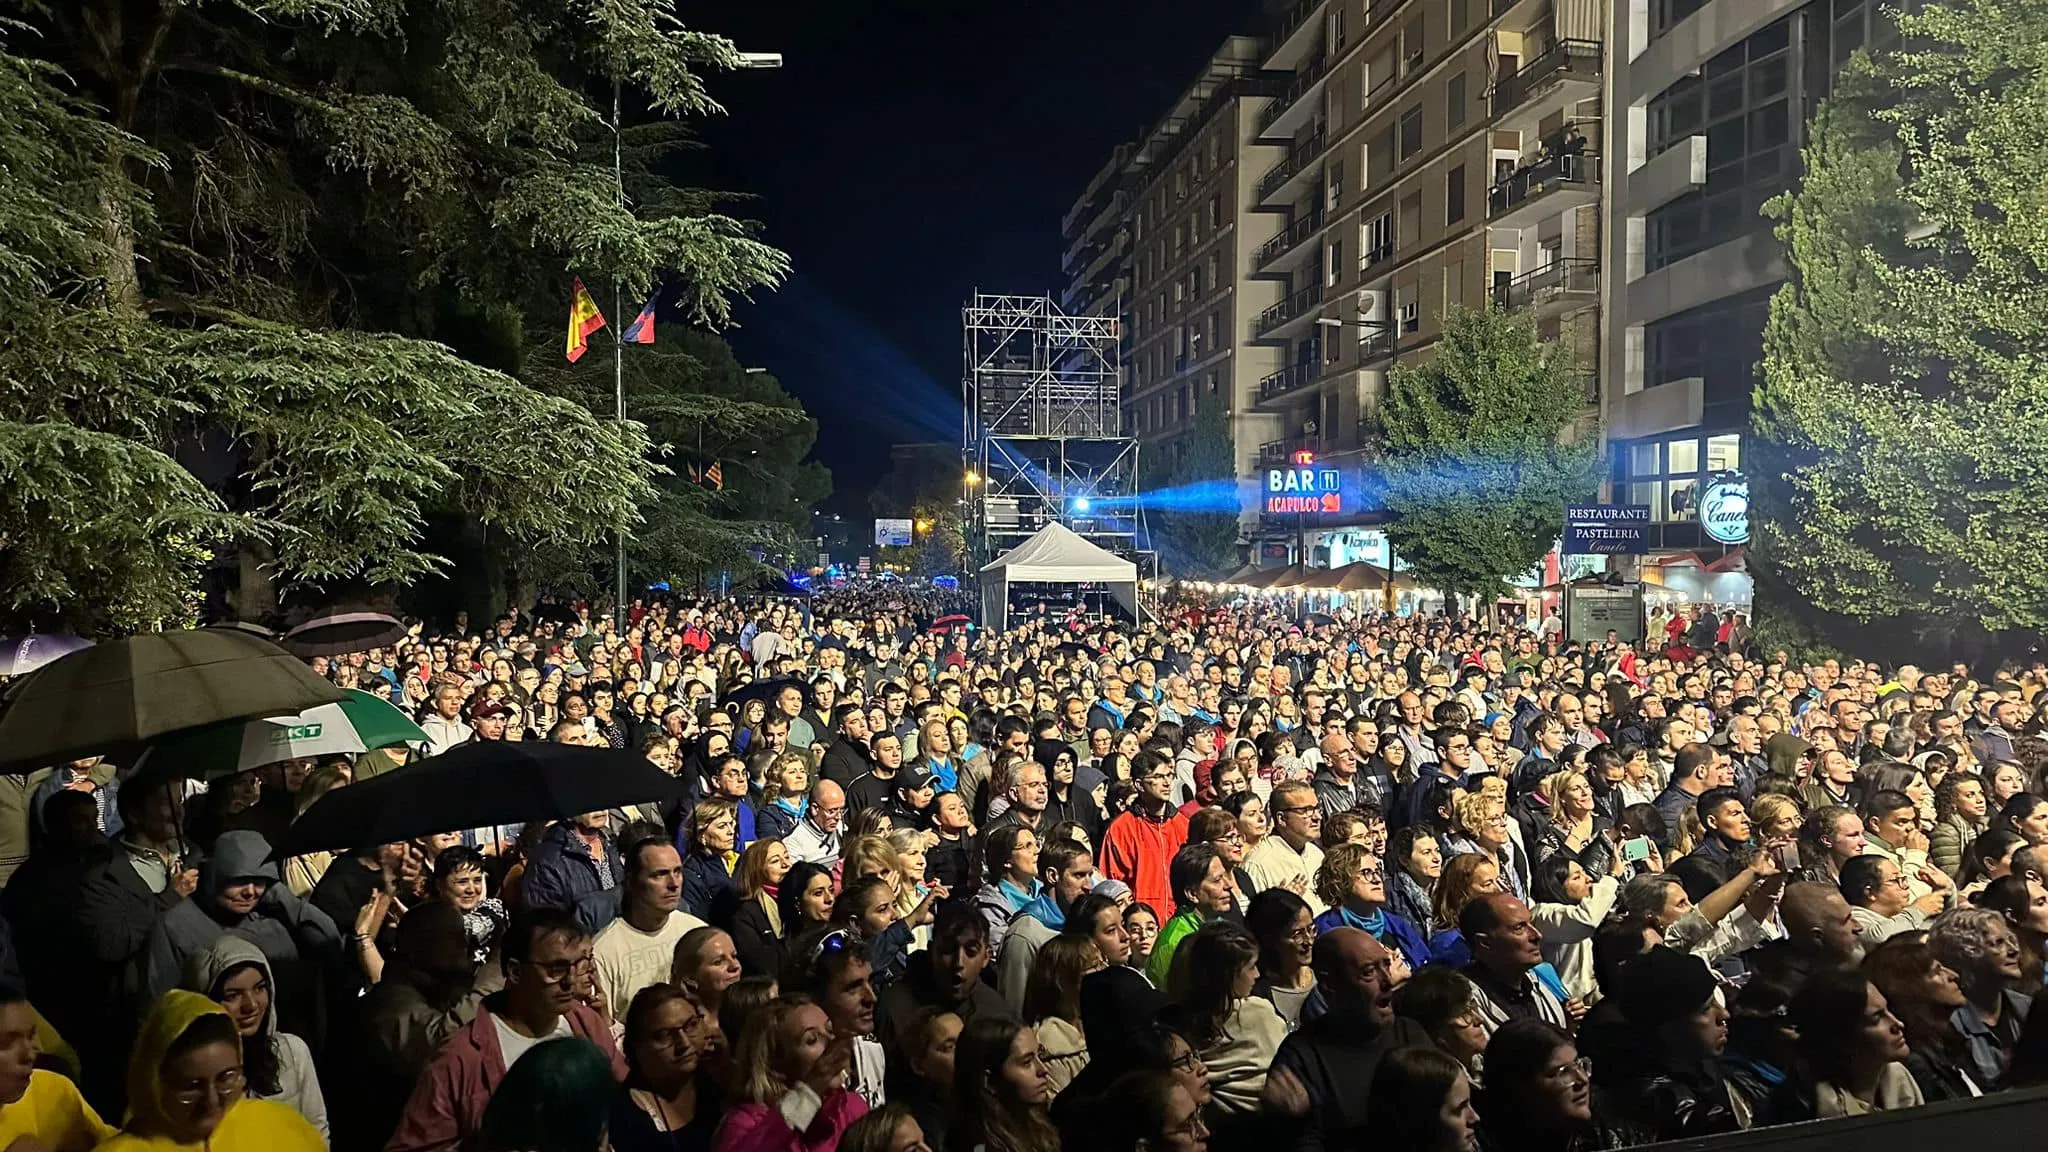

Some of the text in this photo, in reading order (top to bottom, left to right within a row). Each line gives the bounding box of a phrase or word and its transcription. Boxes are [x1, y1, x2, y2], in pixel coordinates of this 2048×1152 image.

[1270, 469, 1314, 491] BAR
[1268, 496, 1319, 512] ACAPULCO
[1569, 508, 1648, 519] RESTAURANTE
[1576, 528, 1640, 539] PASTELERIA
